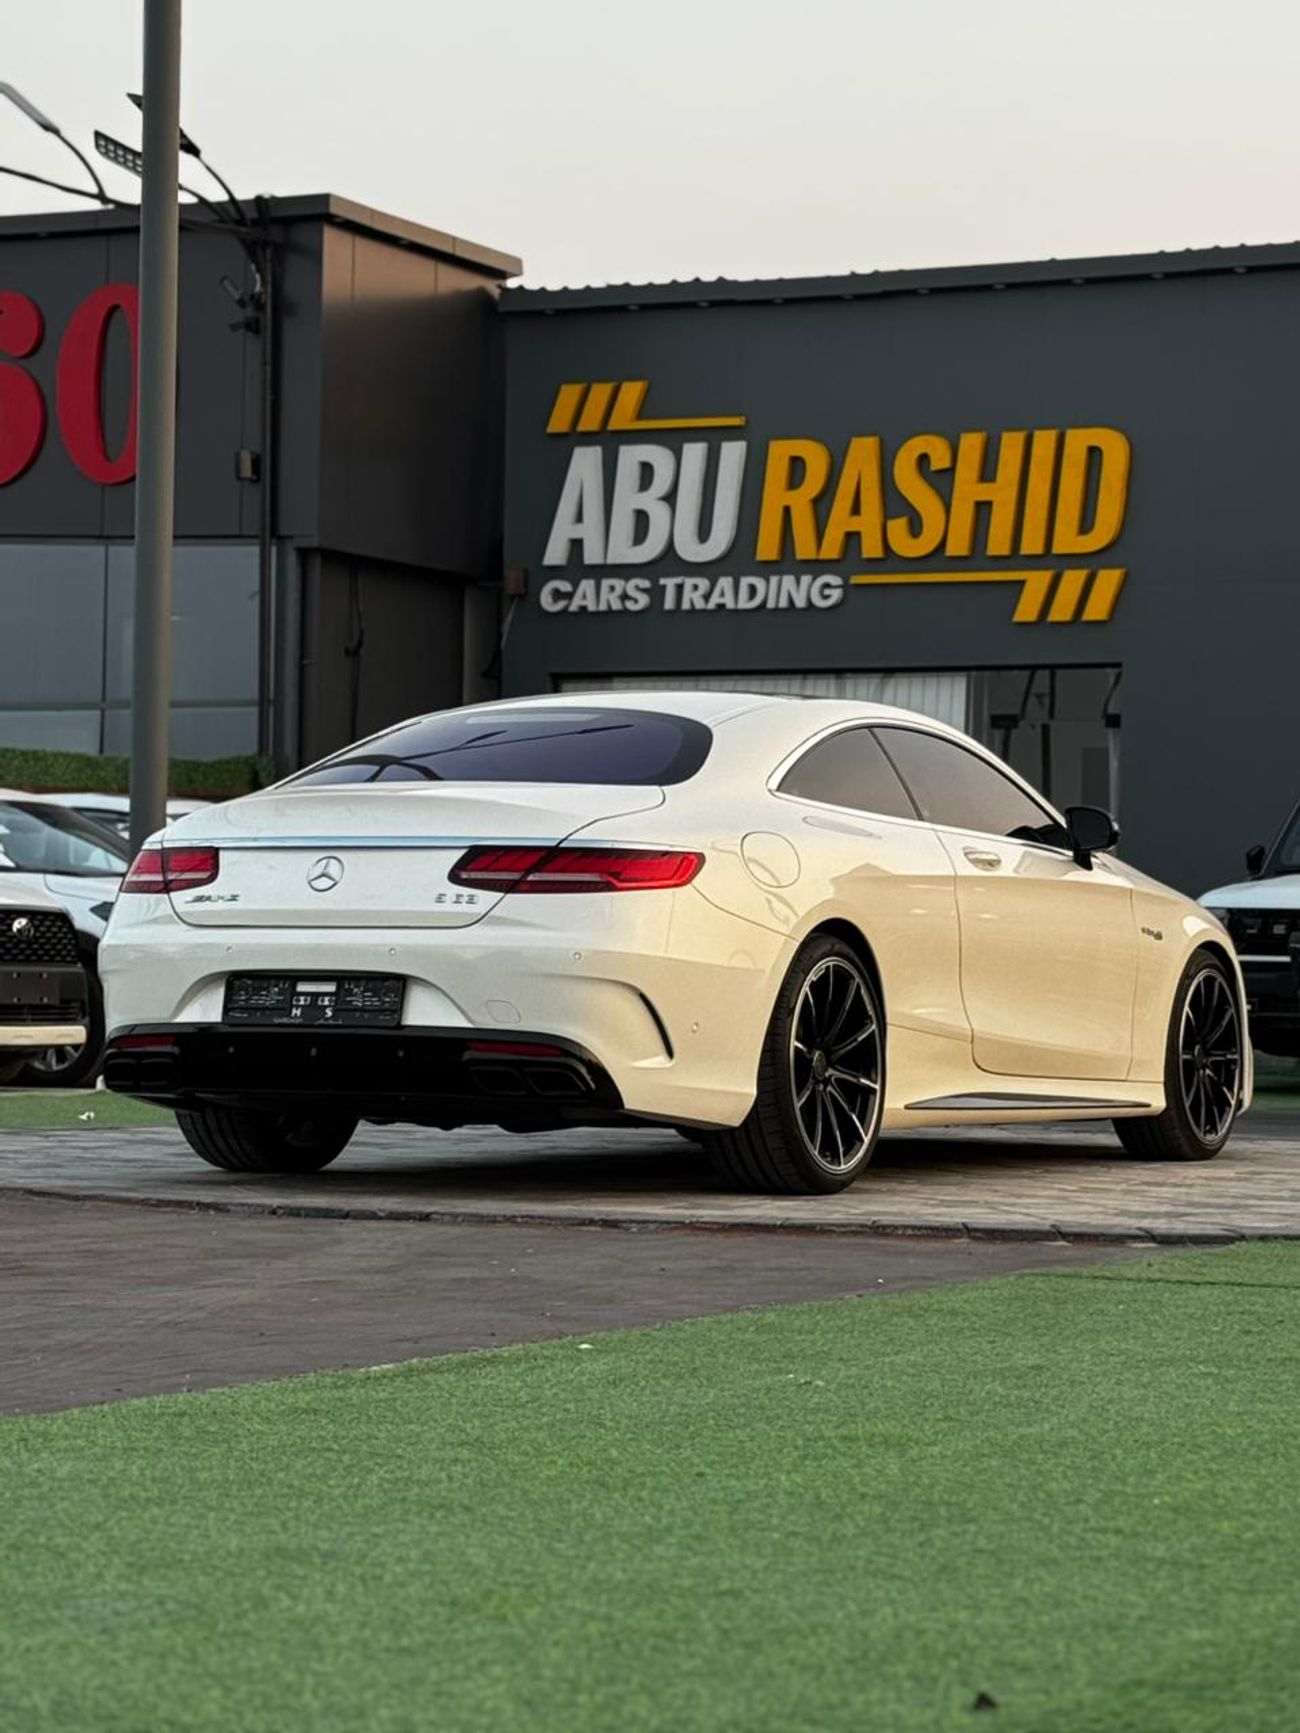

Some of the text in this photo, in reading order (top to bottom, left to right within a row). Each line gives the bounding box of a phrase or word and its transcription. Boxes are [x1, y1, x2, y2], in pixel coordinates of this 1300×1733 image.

[542, 426, 1131, 566] ABU RASHID
[540, 574, 844, 613] CARS TRADING
